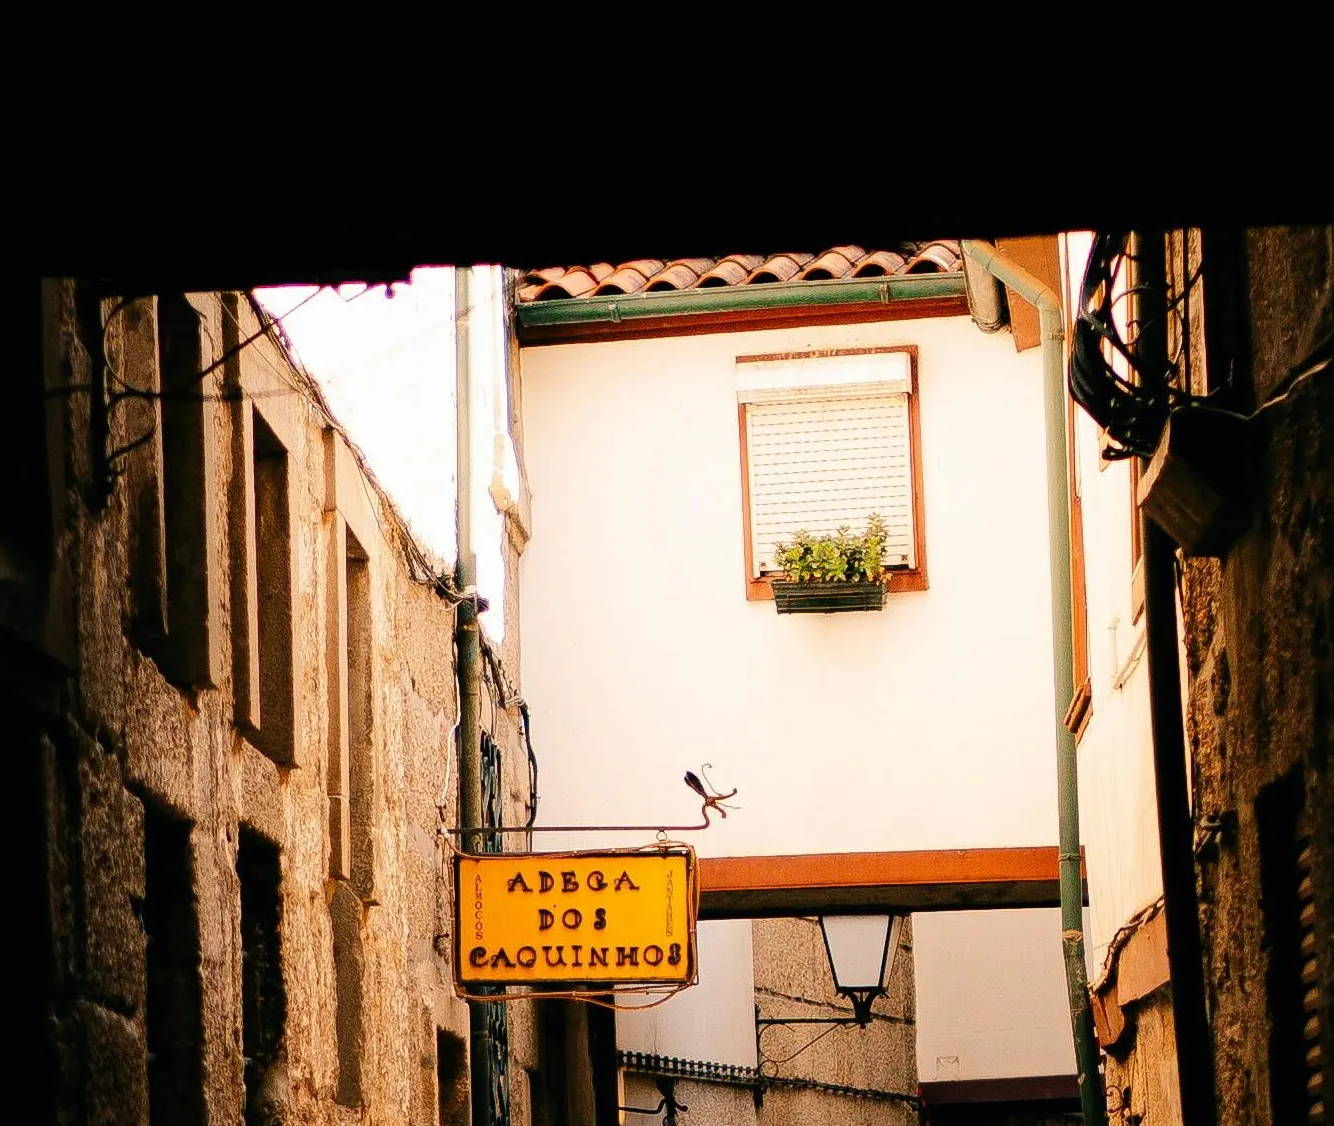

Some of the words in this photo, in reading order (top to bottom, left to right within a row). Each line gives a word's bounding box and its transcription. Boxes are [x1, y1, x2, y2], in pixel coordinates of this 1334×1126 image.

[507, 871, 640, 893] ADEGA
[539, 908, 607, 931] DOS
[469, 943, 681, 969] CAQUINHOS
